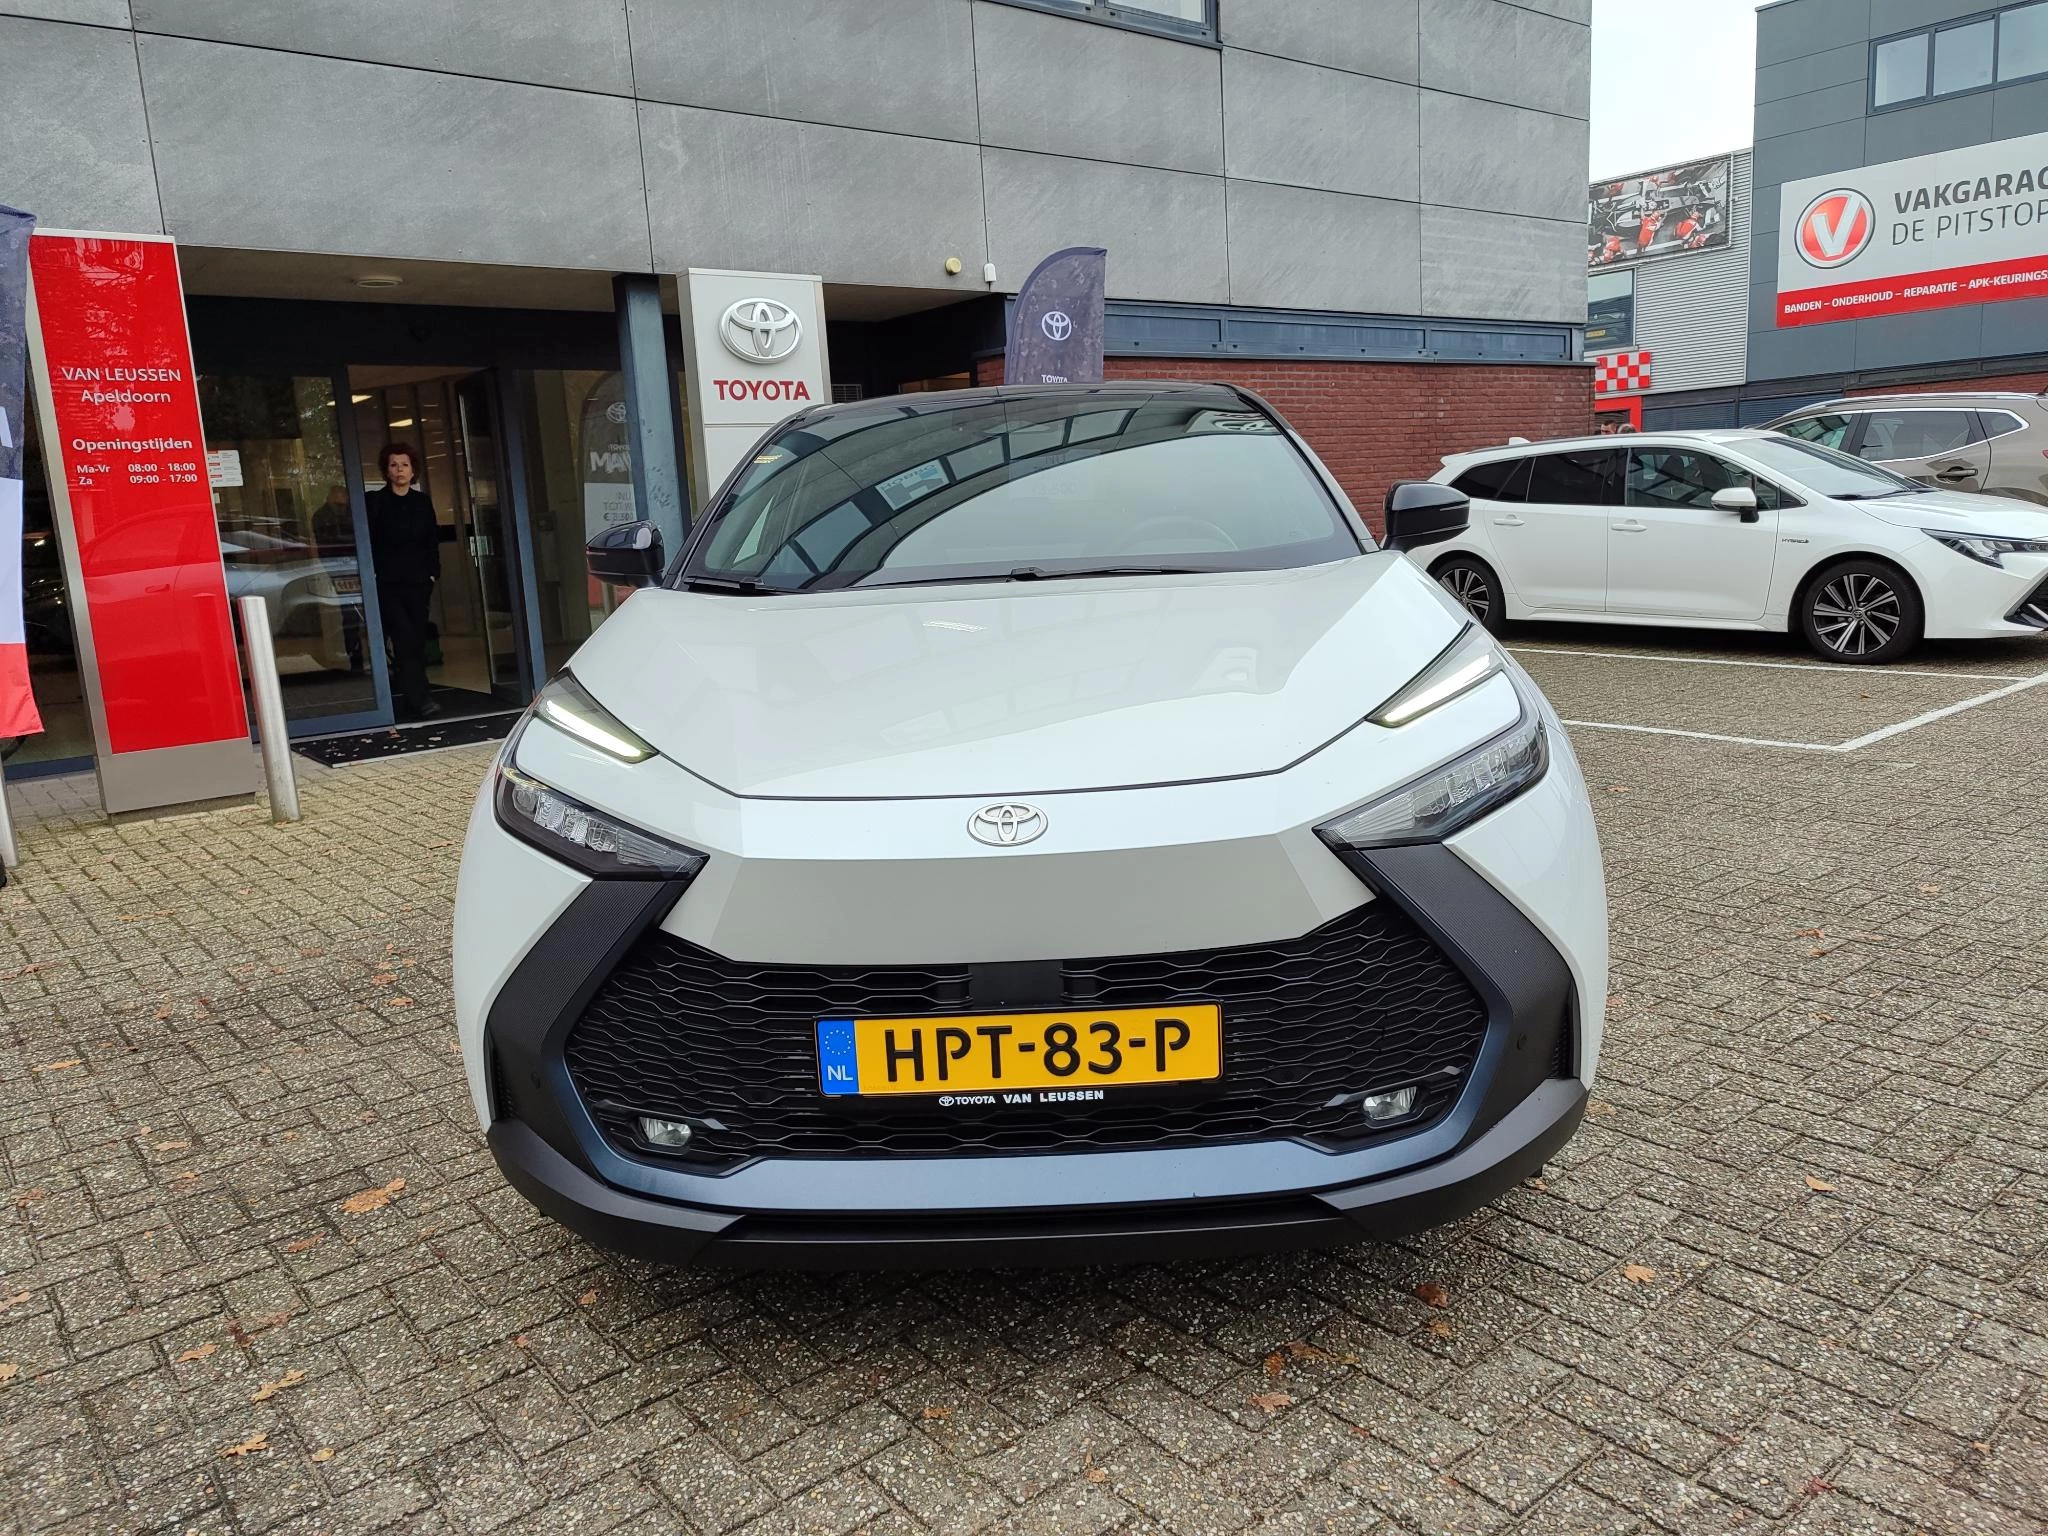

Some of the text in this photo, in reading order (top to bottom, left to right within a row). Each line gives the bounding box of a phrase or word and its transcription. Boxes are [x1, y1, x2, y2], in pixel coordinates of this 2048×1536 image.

[1892, 198, 2048, 246] DE PITSTOP
[1784, 300, 1822, 314] BANDEN
[1832, 290, 1893, 308] ONDERHOUD
[1903, 281, 1958, 298] REPARATIE
[62, 367, 181, 381] VAN LEUSSEN
[81, 389, 171, 405] Apeldoorn
[713, 380, 811, 401] TOYOTA
[72, 438, 193, 454] Openingstijden
[76, 464, 111, 474] Ma-Vr
[127, 463, 158, 473] 08:00
[167, 462, 196, 472] 18:00
[78, 476, 93, 486] Za
[129, 475, 160, 484] 09:00
[169, 473, 198, 483] 17:00
[884, 1018, 1191, 1082] HPT-83-P
[827, 1064, 853, 1082] NL
[955, 1090, 1104, 1105] TOYOTA VAN LEUSSEN
